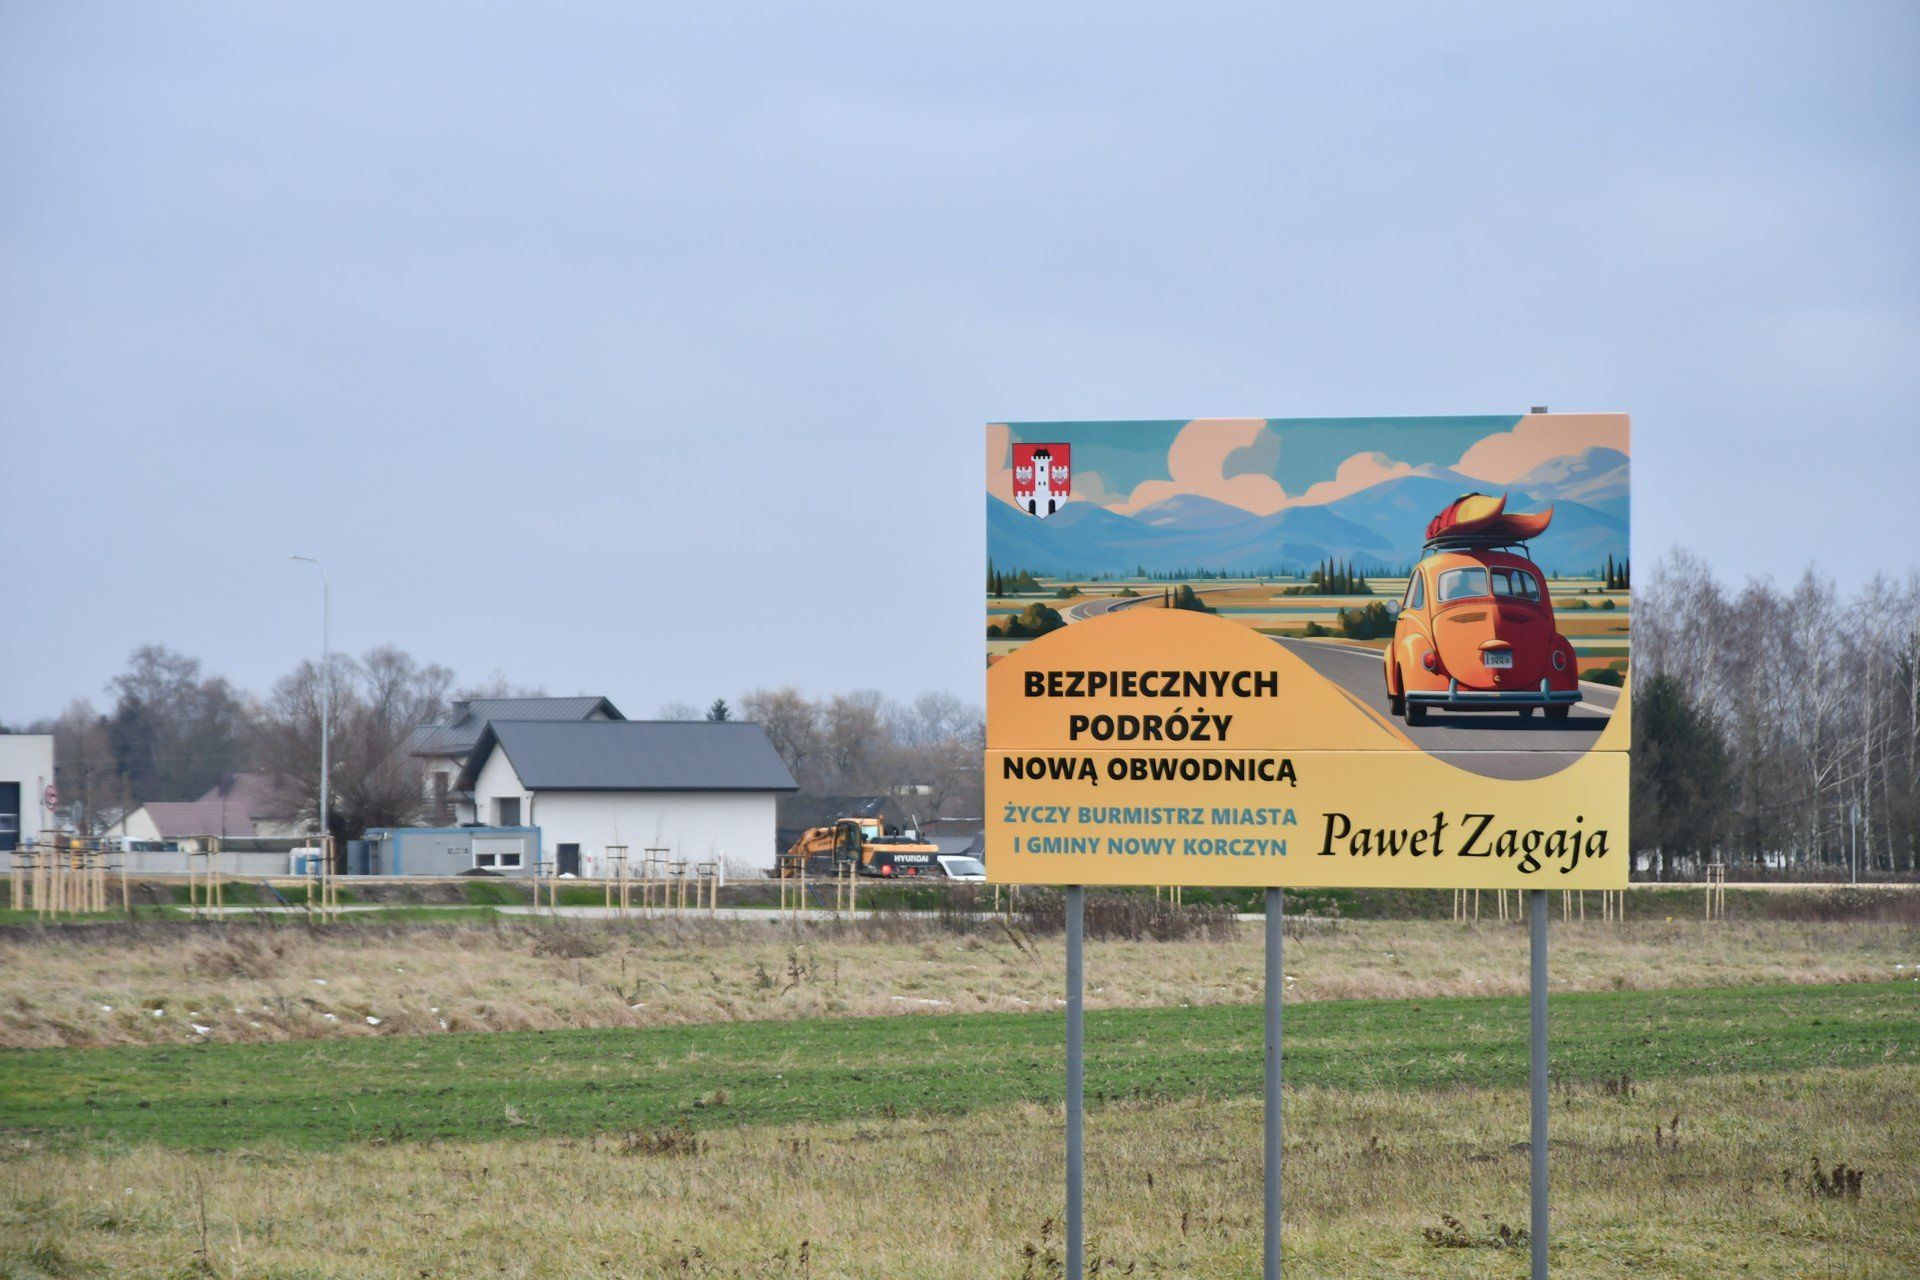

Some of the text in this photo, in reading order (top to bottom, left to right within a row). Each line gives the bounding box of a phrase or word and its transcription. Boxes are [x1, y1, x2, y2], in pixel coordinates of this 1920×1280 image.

[1023, 669, 1279, 698] BEZPIECZNYCH
[1068, 706, 1234, 742] PODRÓŻY
[1002, 756, 1298, 788] NOWĄ OBWODNICĄ
[1003, 800, 1298, 826] ŻYCZY BURMISTRZ MIASTA
[1013, 836, 1287, 857] I GMINY NOWY KORCZYN
[1317, 810, 1610, 875] Paweł Zagaja
[894, 854, 929, 863] HYUNDAI
